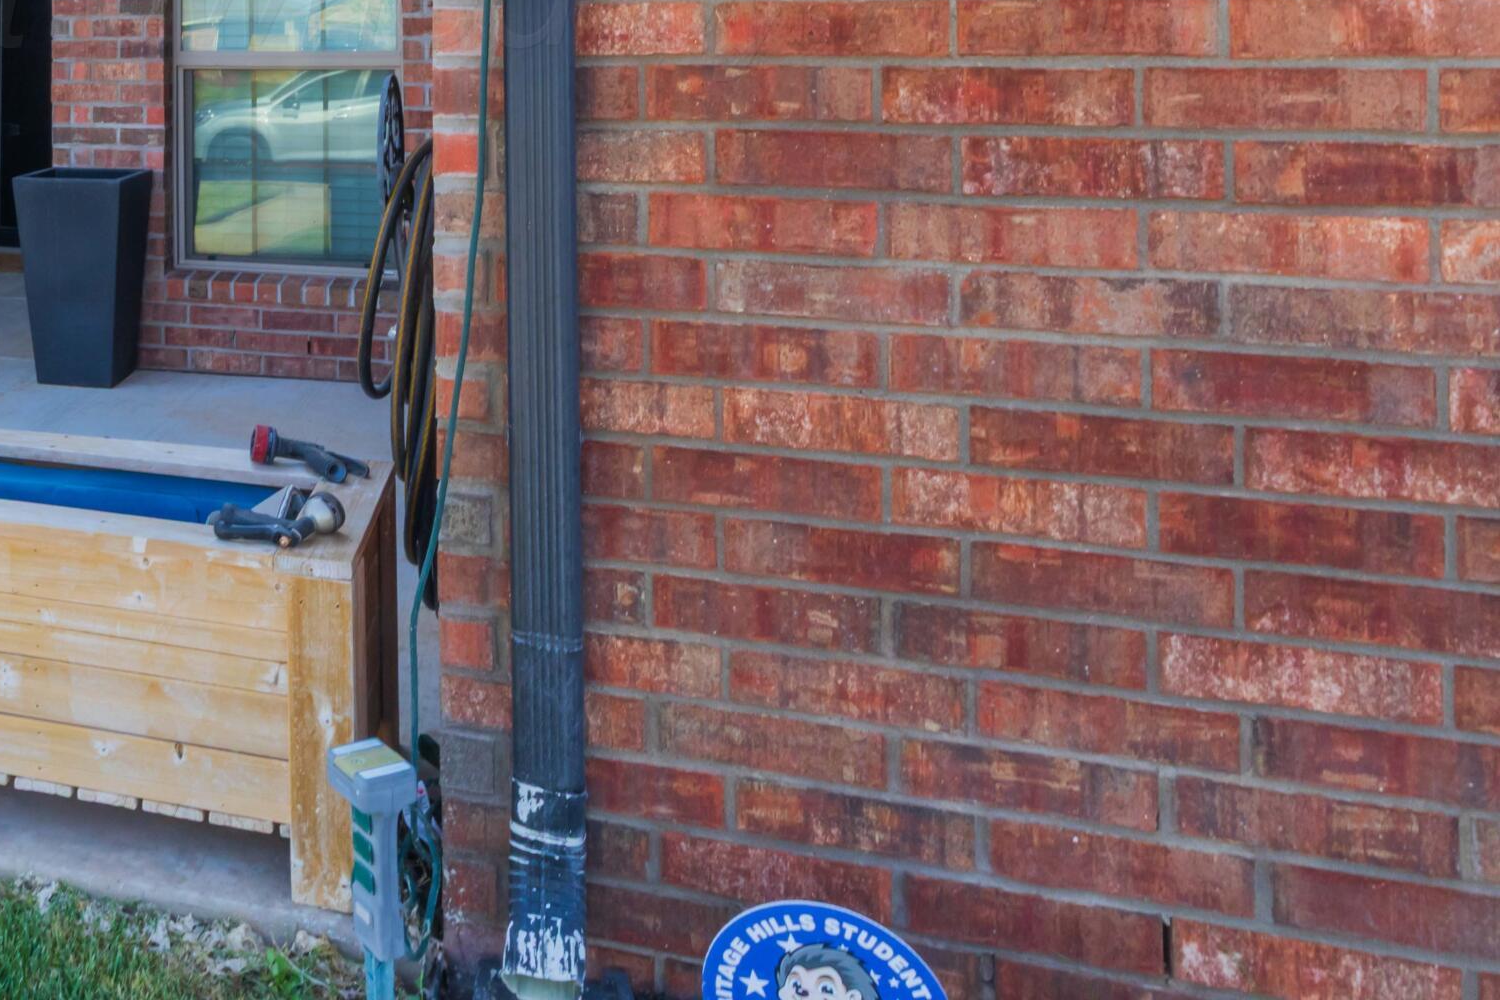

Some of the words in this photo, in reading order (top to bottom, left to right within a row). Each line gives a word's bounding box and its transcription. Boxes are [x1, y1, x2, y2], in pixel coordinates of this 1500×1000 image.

[715, 936, 751, 1000] ITAGE
[746, 914, 816, 944] HILLS
[824, 917, 932, 1000] STUDENT
